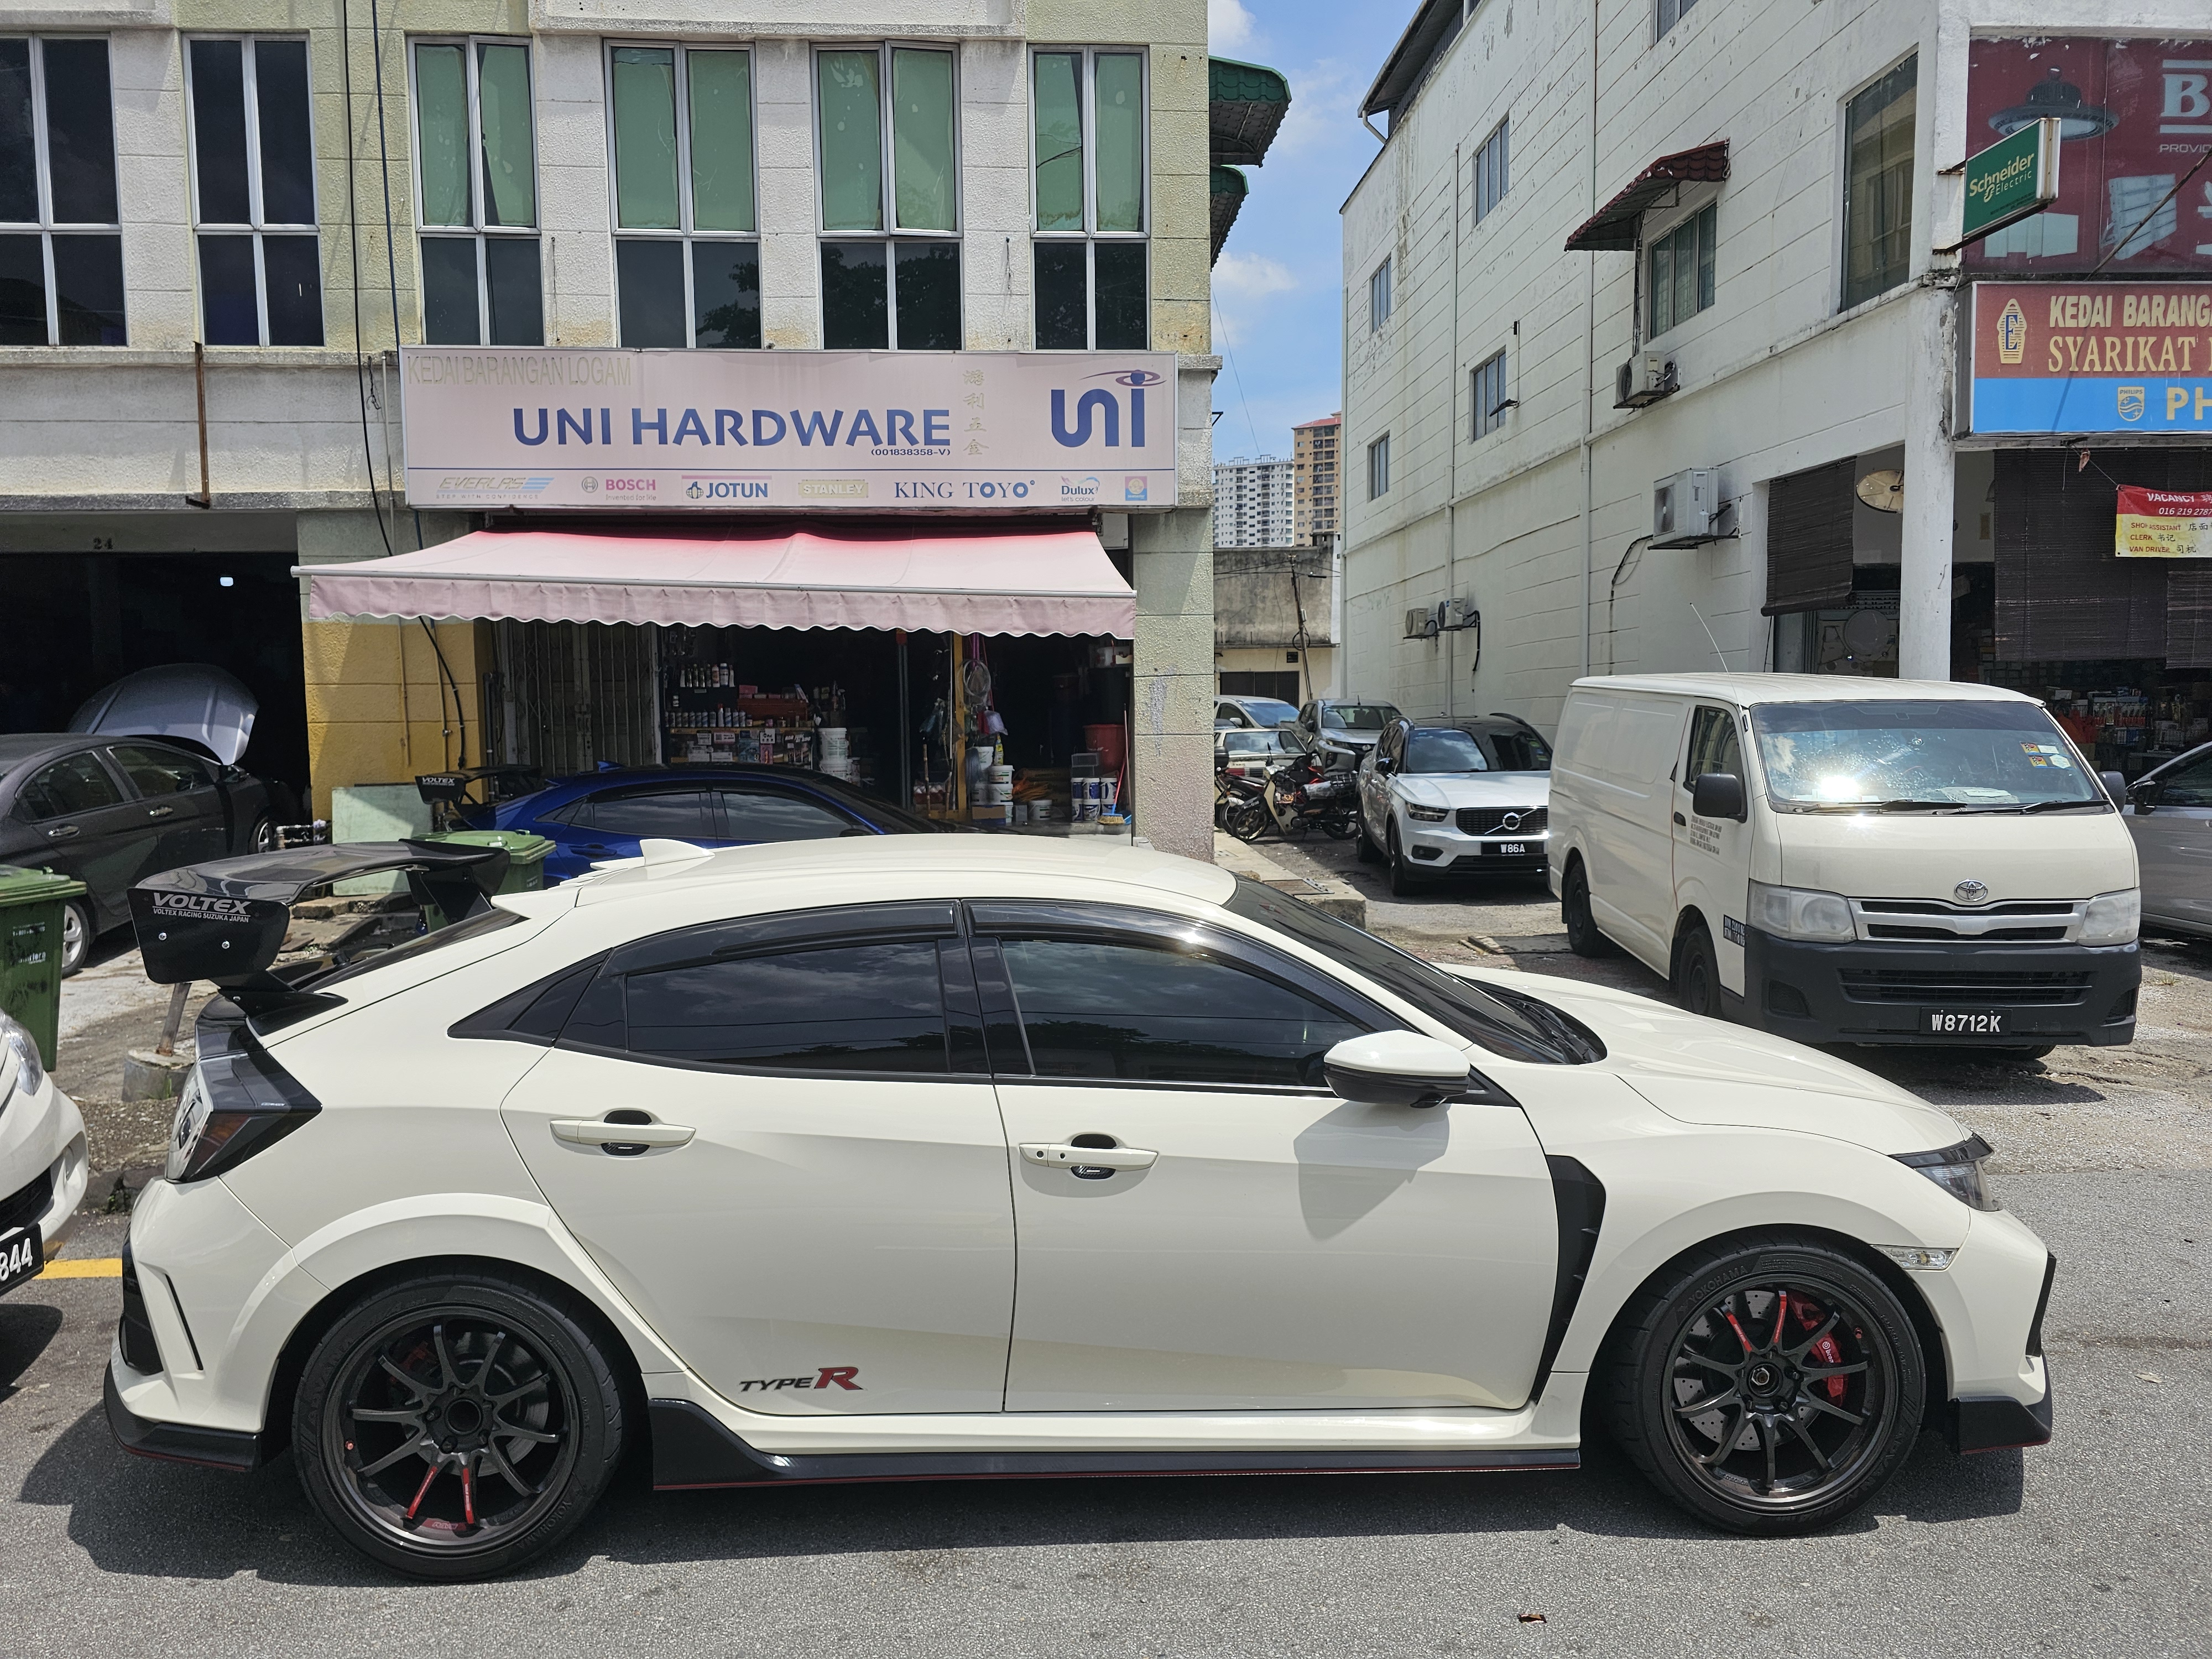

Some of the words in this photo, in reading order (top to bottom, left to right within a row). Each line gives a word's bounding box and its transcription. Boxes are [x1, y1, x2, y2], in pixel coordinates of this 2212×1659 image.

[1969, 153, 2034, 197] Schneider
[1995, 170, 2032, 195] Electric
[2049, 295, 2113, 327] KEDAI
[2123, 294, 2212, 327] BARANG
[2048, 336, 2196, 372] SYARIKAT
[407, 356, 460, 385] KEDAI
[463, 356, 563, 385] BARANGAN
[567, 357, 632, 385] LOGAM
[513, 408, 611, 446] UNI
[632, 408, 951, 446] HARDWARE
[870, 448, 951, 456] (001838358-V)
[606, 479, 656, 491] BOSCH
[706, 482, 768, 498] JOTUN
[804, 484, 864, 495] STANLEY
[894, 482, 954, 499] KING
[1061, 486, 1095, 495] Dulux
[2147, 493, 2195, 503] VACANCY
[2188, 523, 2212, 531] 店面
[93, 538, 113, 550] 24
[2157, 533, 2176, 542] 书记
[2177, 545, 2197, 554] 司机
[1500, 844, 1525, 853] W86A
[154, 892, 252, 915] VOLTEX
[153, 908, 177, 916] VOLTEX
[178, 910, 202, 919] RACING
[202, 912, 228, 921] SUZUKA
[1931, 1014, 2002, 1033] W8712K
[1688, 1265, 1749, 1304] YOKOHAMA
[739, 1376, 815, 1392] TYPE
[814, 1366, 863, 1391] R
